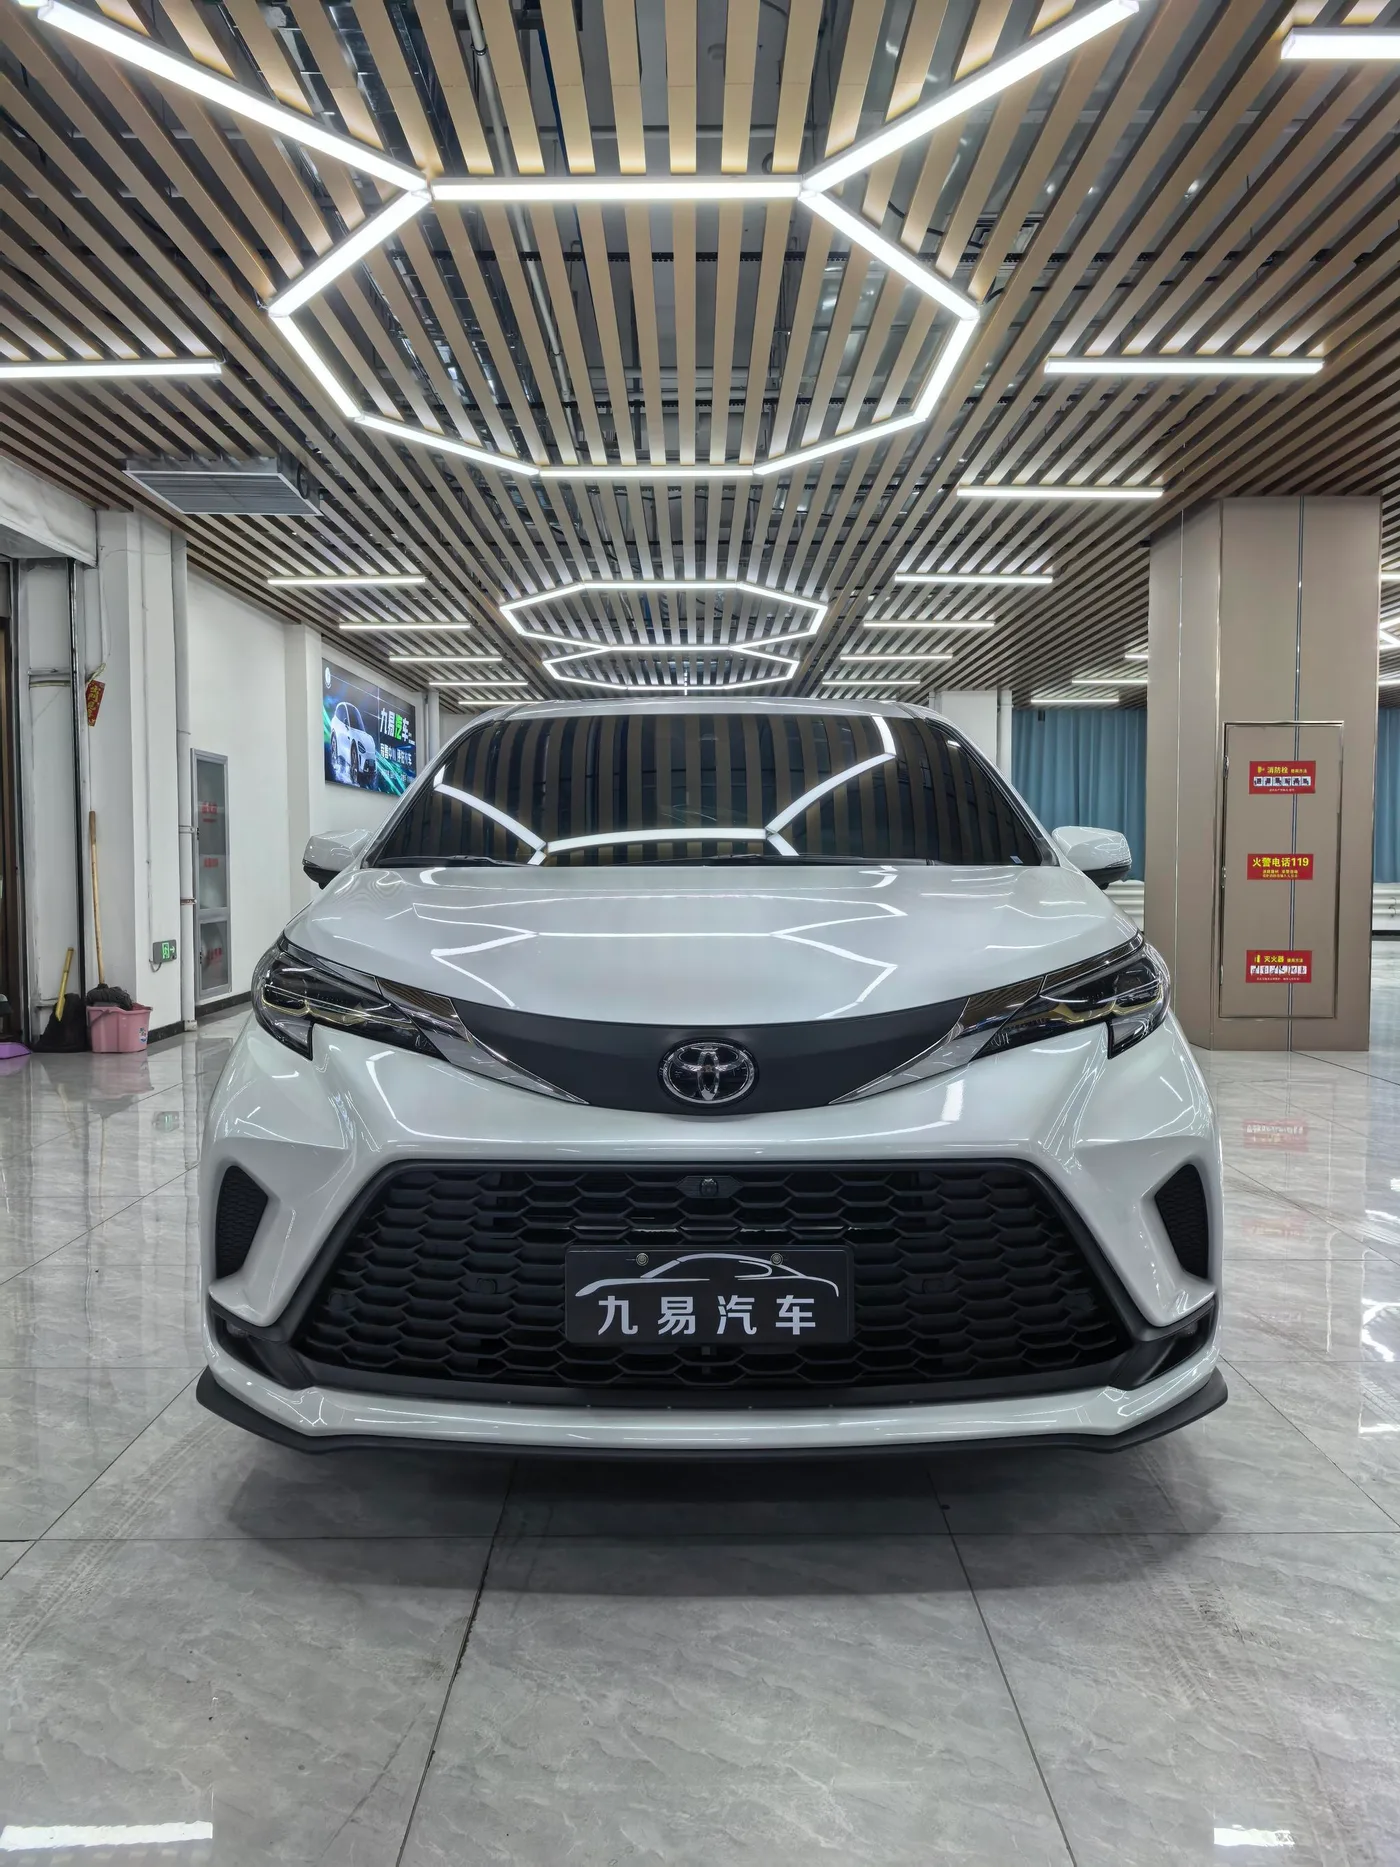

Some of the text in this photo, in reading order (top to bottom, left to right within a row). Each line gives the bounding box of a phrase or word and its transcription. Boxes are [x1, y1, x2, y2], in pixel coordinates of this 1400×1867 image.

[1252, 857, 1310, 867] 火警电话119
[598, 1295, 816, 1335] 九易汽车
